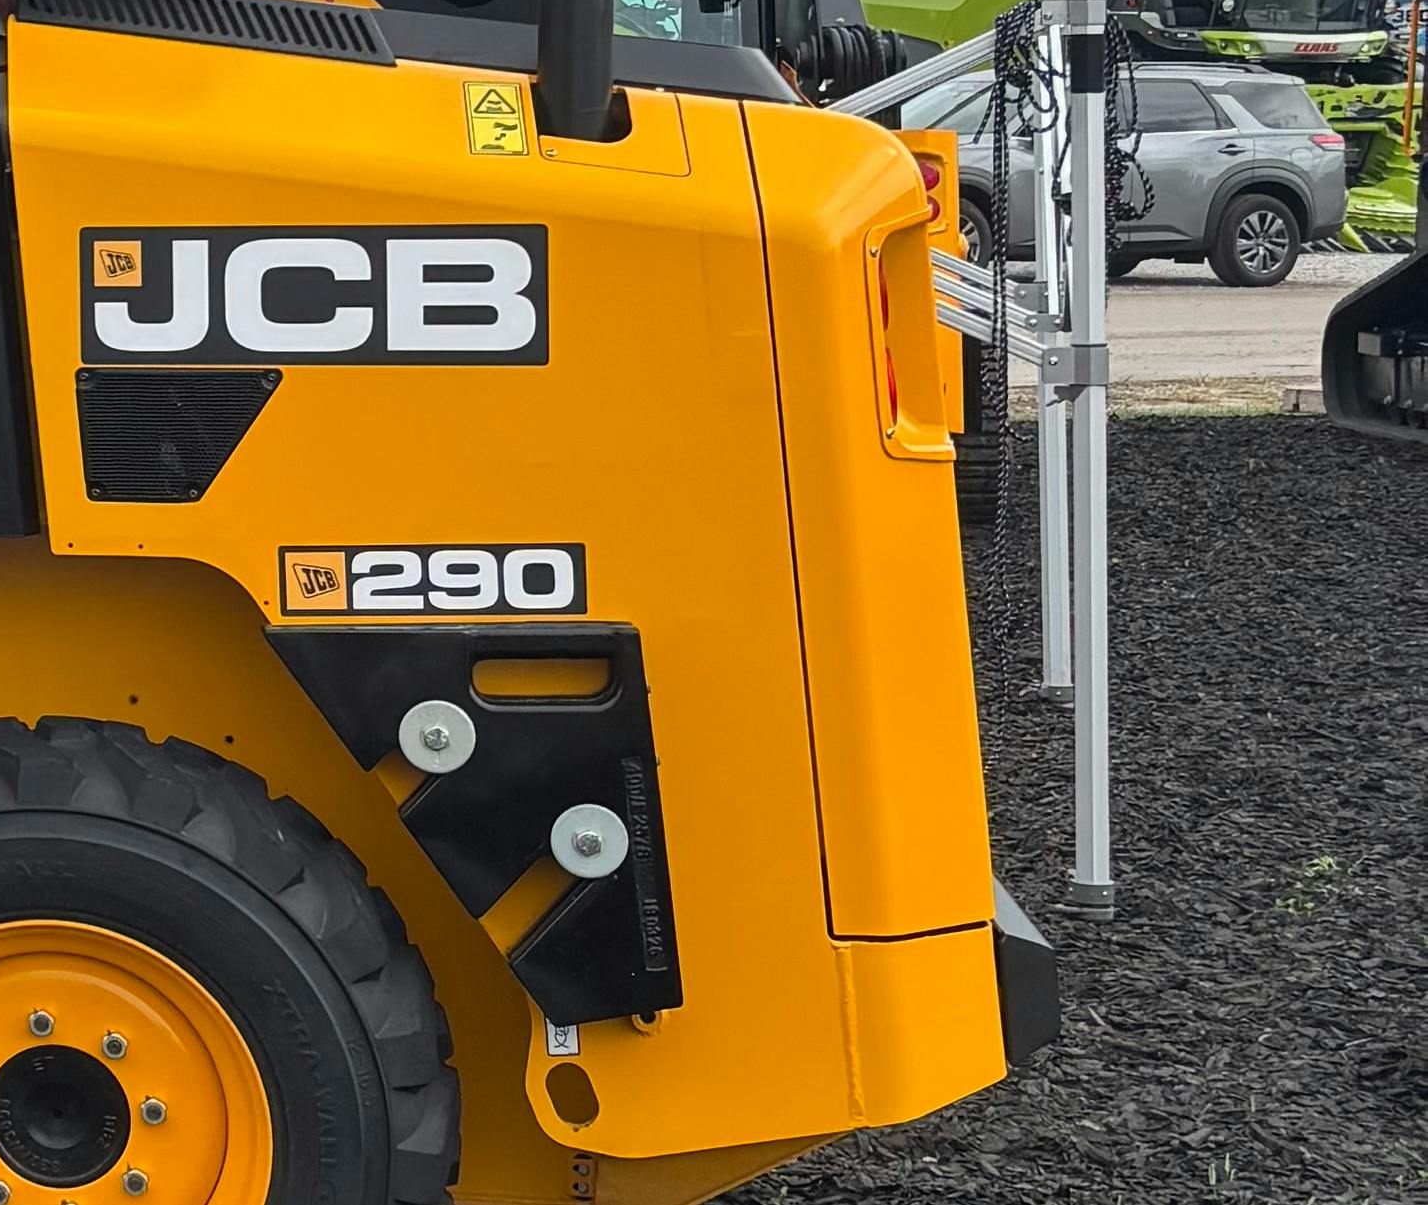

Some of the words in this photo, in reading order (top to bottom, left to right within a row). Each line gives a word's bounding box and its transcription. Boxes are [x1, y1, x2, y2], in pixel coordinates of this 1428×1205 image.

[1294, 42, 1340, 53] CLAAS
[105, 251, 136, 279] JCB
[94, 237, 537, 353] JCB
[302, 565, 339, 596] JCB
[351, 550, 575, 612] 290
